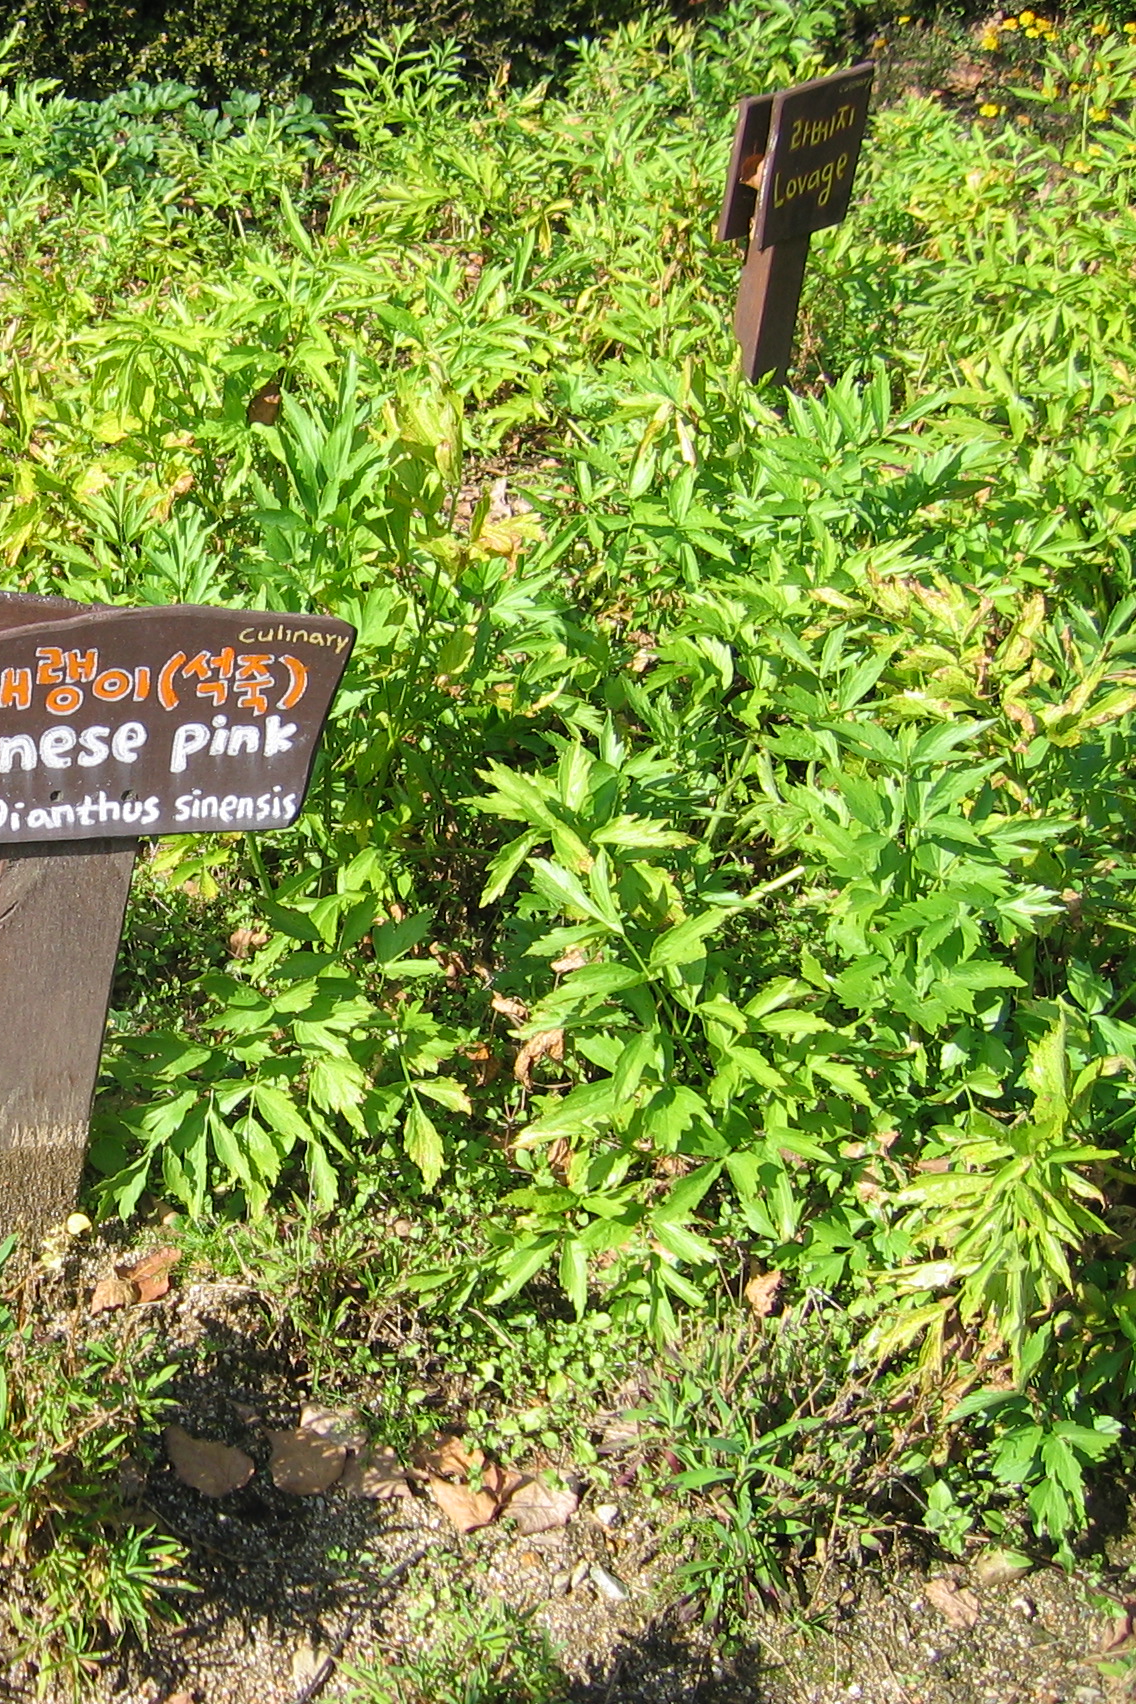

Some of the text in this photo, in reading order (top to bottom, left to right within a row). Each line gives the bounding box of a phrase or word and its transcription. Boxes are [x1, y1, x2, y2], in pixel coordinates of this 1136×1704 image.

[774, 152, 848, 209] Lovage
[169, 714, 298, 773] pink
[174, 786, 296, 821] sinensis
